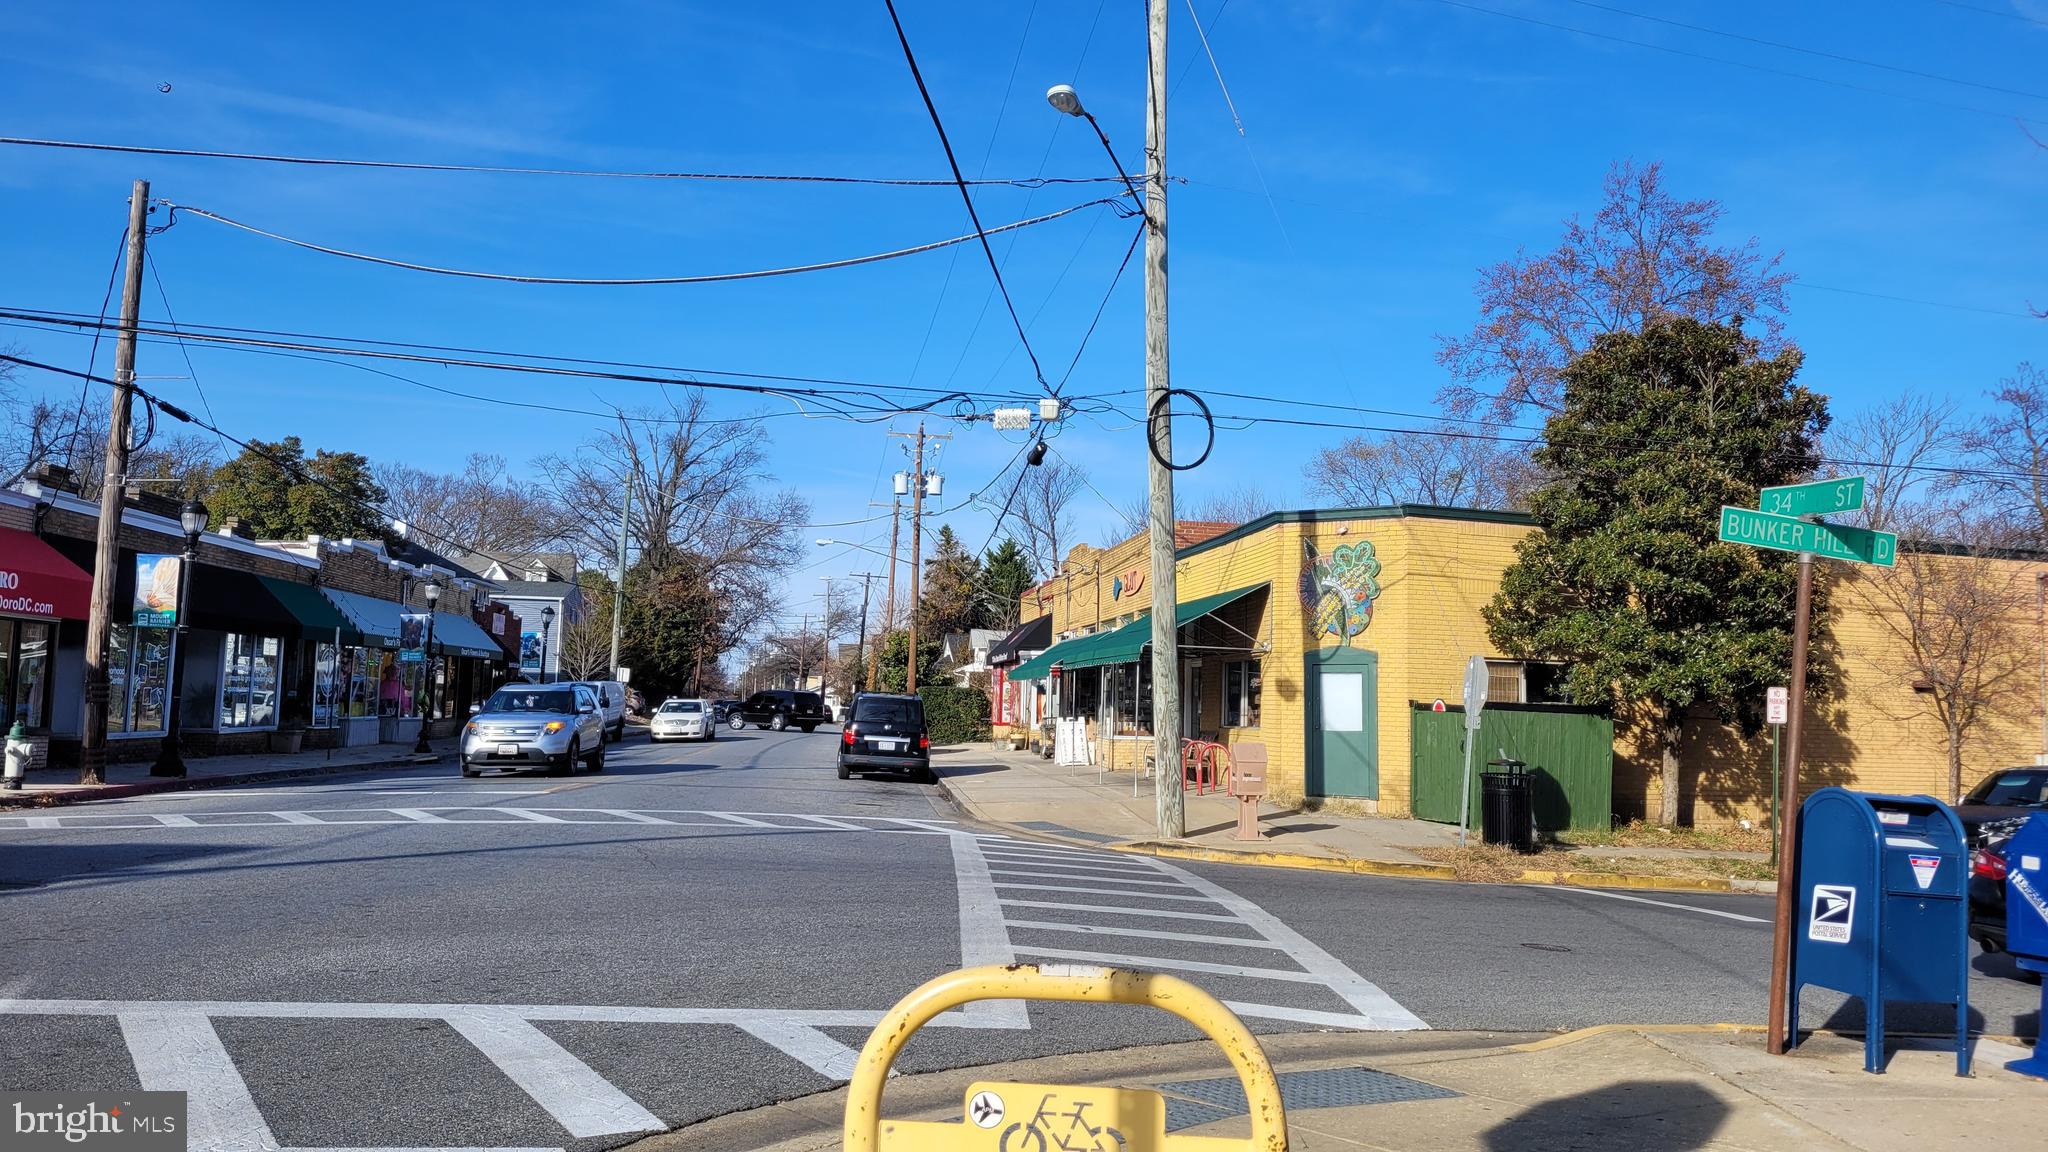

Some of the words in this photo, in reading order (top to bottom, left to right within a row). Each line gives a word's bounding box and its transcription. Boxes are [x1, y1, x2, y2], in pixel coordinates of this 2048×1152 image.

[1835, 483, 1855, 507] ST
[1727, 514, 1804, 547] BUNKER
[1814, 527, 1854, 555] HILL
[1865, 535, 1889, 560] RD
[1769, 697, 1786, 705] PARKING
[1773, 690, 1781, 698] NO
